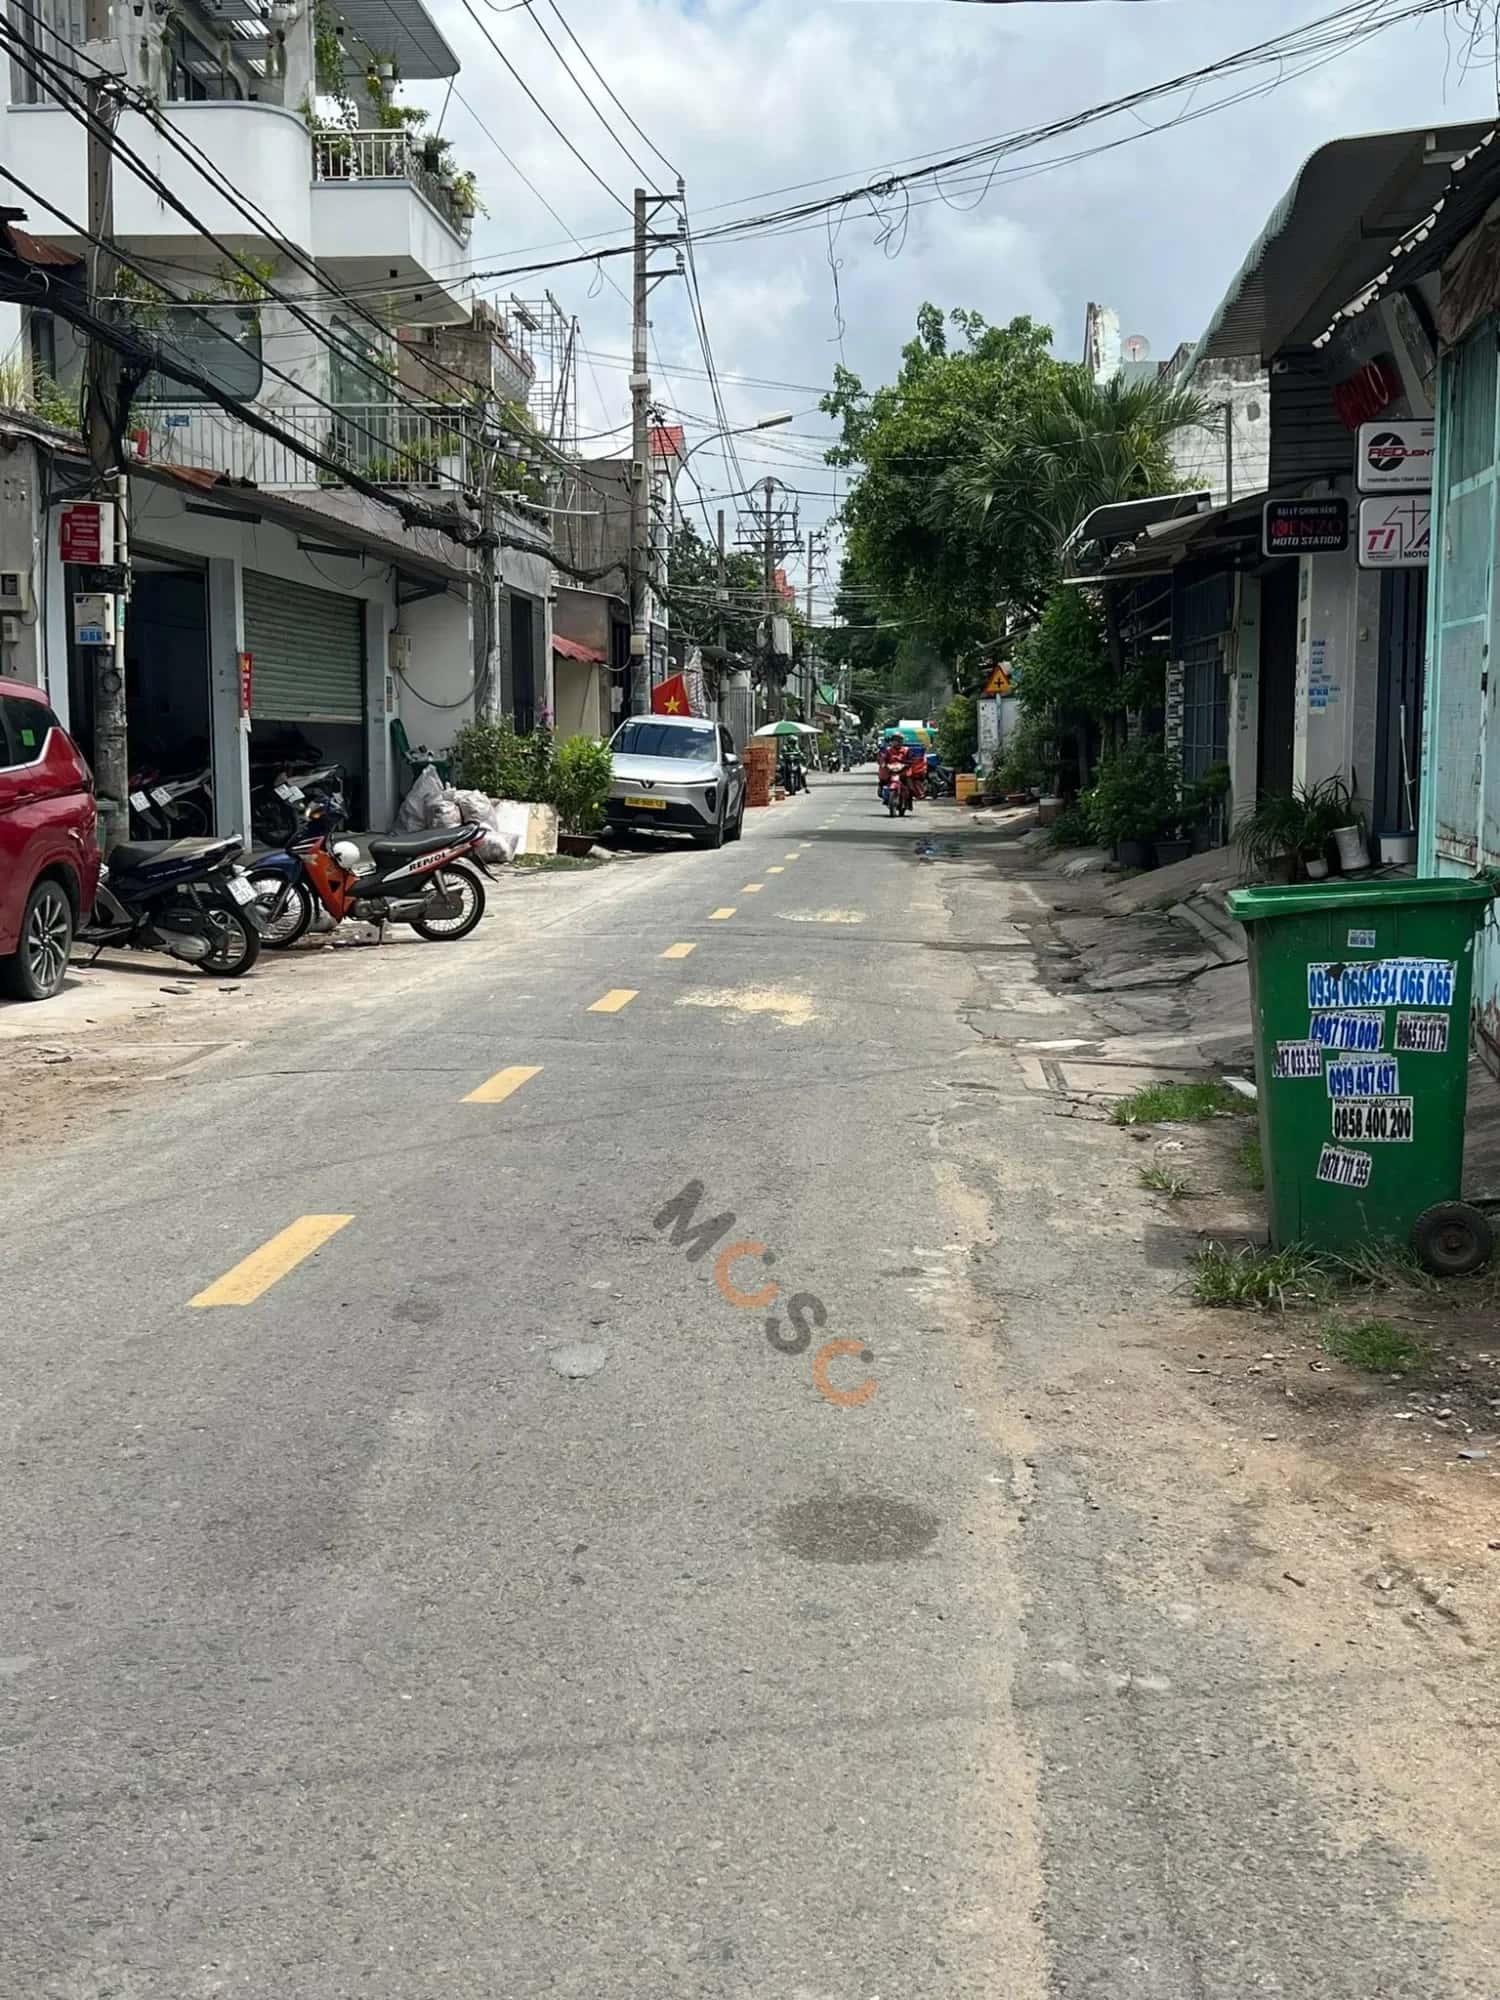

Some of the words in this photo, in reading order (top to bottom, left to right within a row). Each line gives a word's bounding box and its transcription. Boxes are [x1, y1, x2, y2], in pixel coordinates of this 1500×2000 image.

[1272, 536, 1299, 547] MOTO
[1300, 535, 1341, 546] STATION
[1366, 968, 1452, 1005] 0934.066.066
[1329, 1064, 1396, 1096] 0919.487.497
[1334, 1107, 1411, 1138] 0858.400.200
